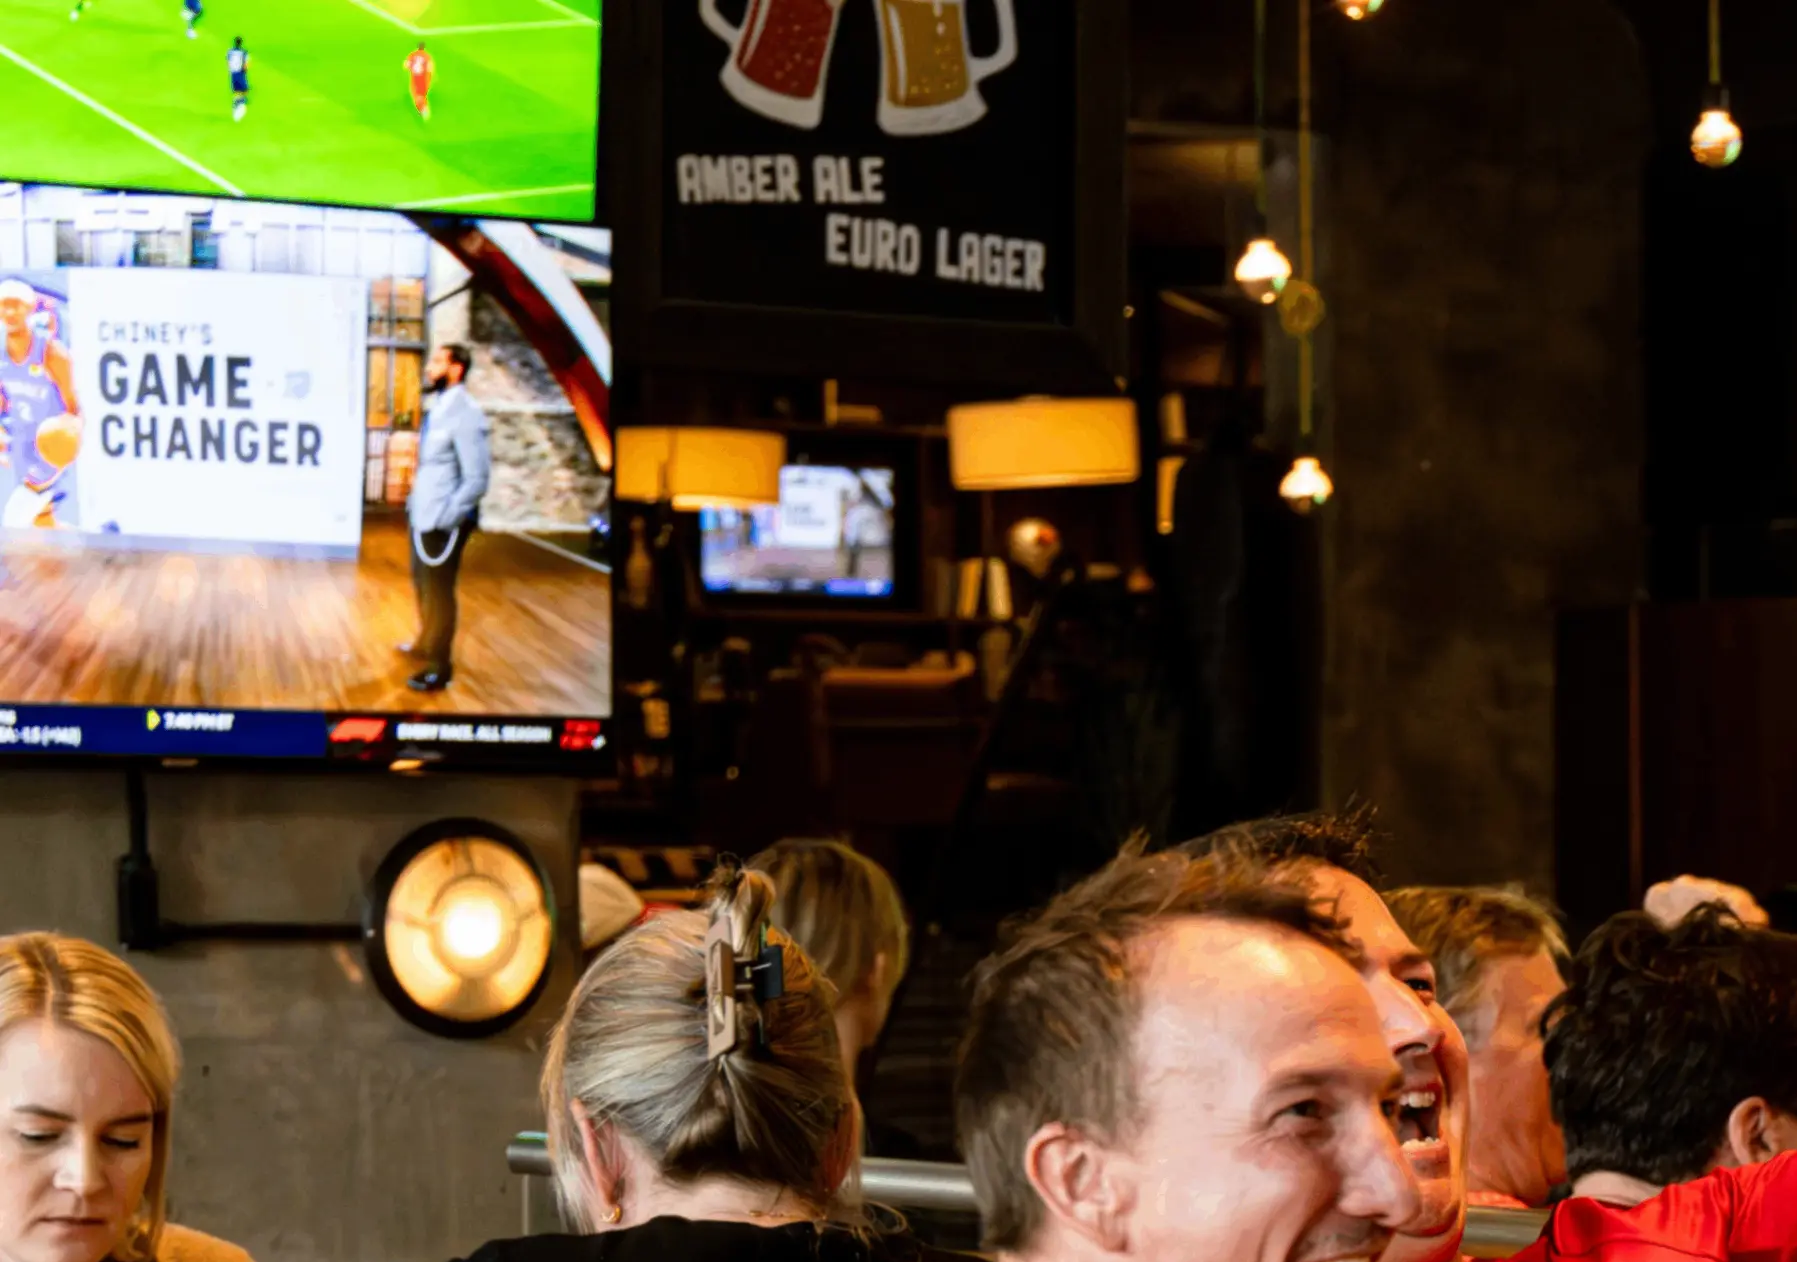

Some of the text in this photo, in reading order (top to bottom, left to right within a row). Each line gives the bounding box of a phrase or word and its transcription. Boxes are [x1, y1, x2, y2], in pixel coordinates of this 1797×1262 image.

[676, 153, 886, 204] AMBER ALE
[825, 213, 1046, 292] EURO LAGER
[98, 320, 214, 345] CHINEY'S
[98, 351, 253, 410] GAME
[100, 413, 323, 467] CHANGER
